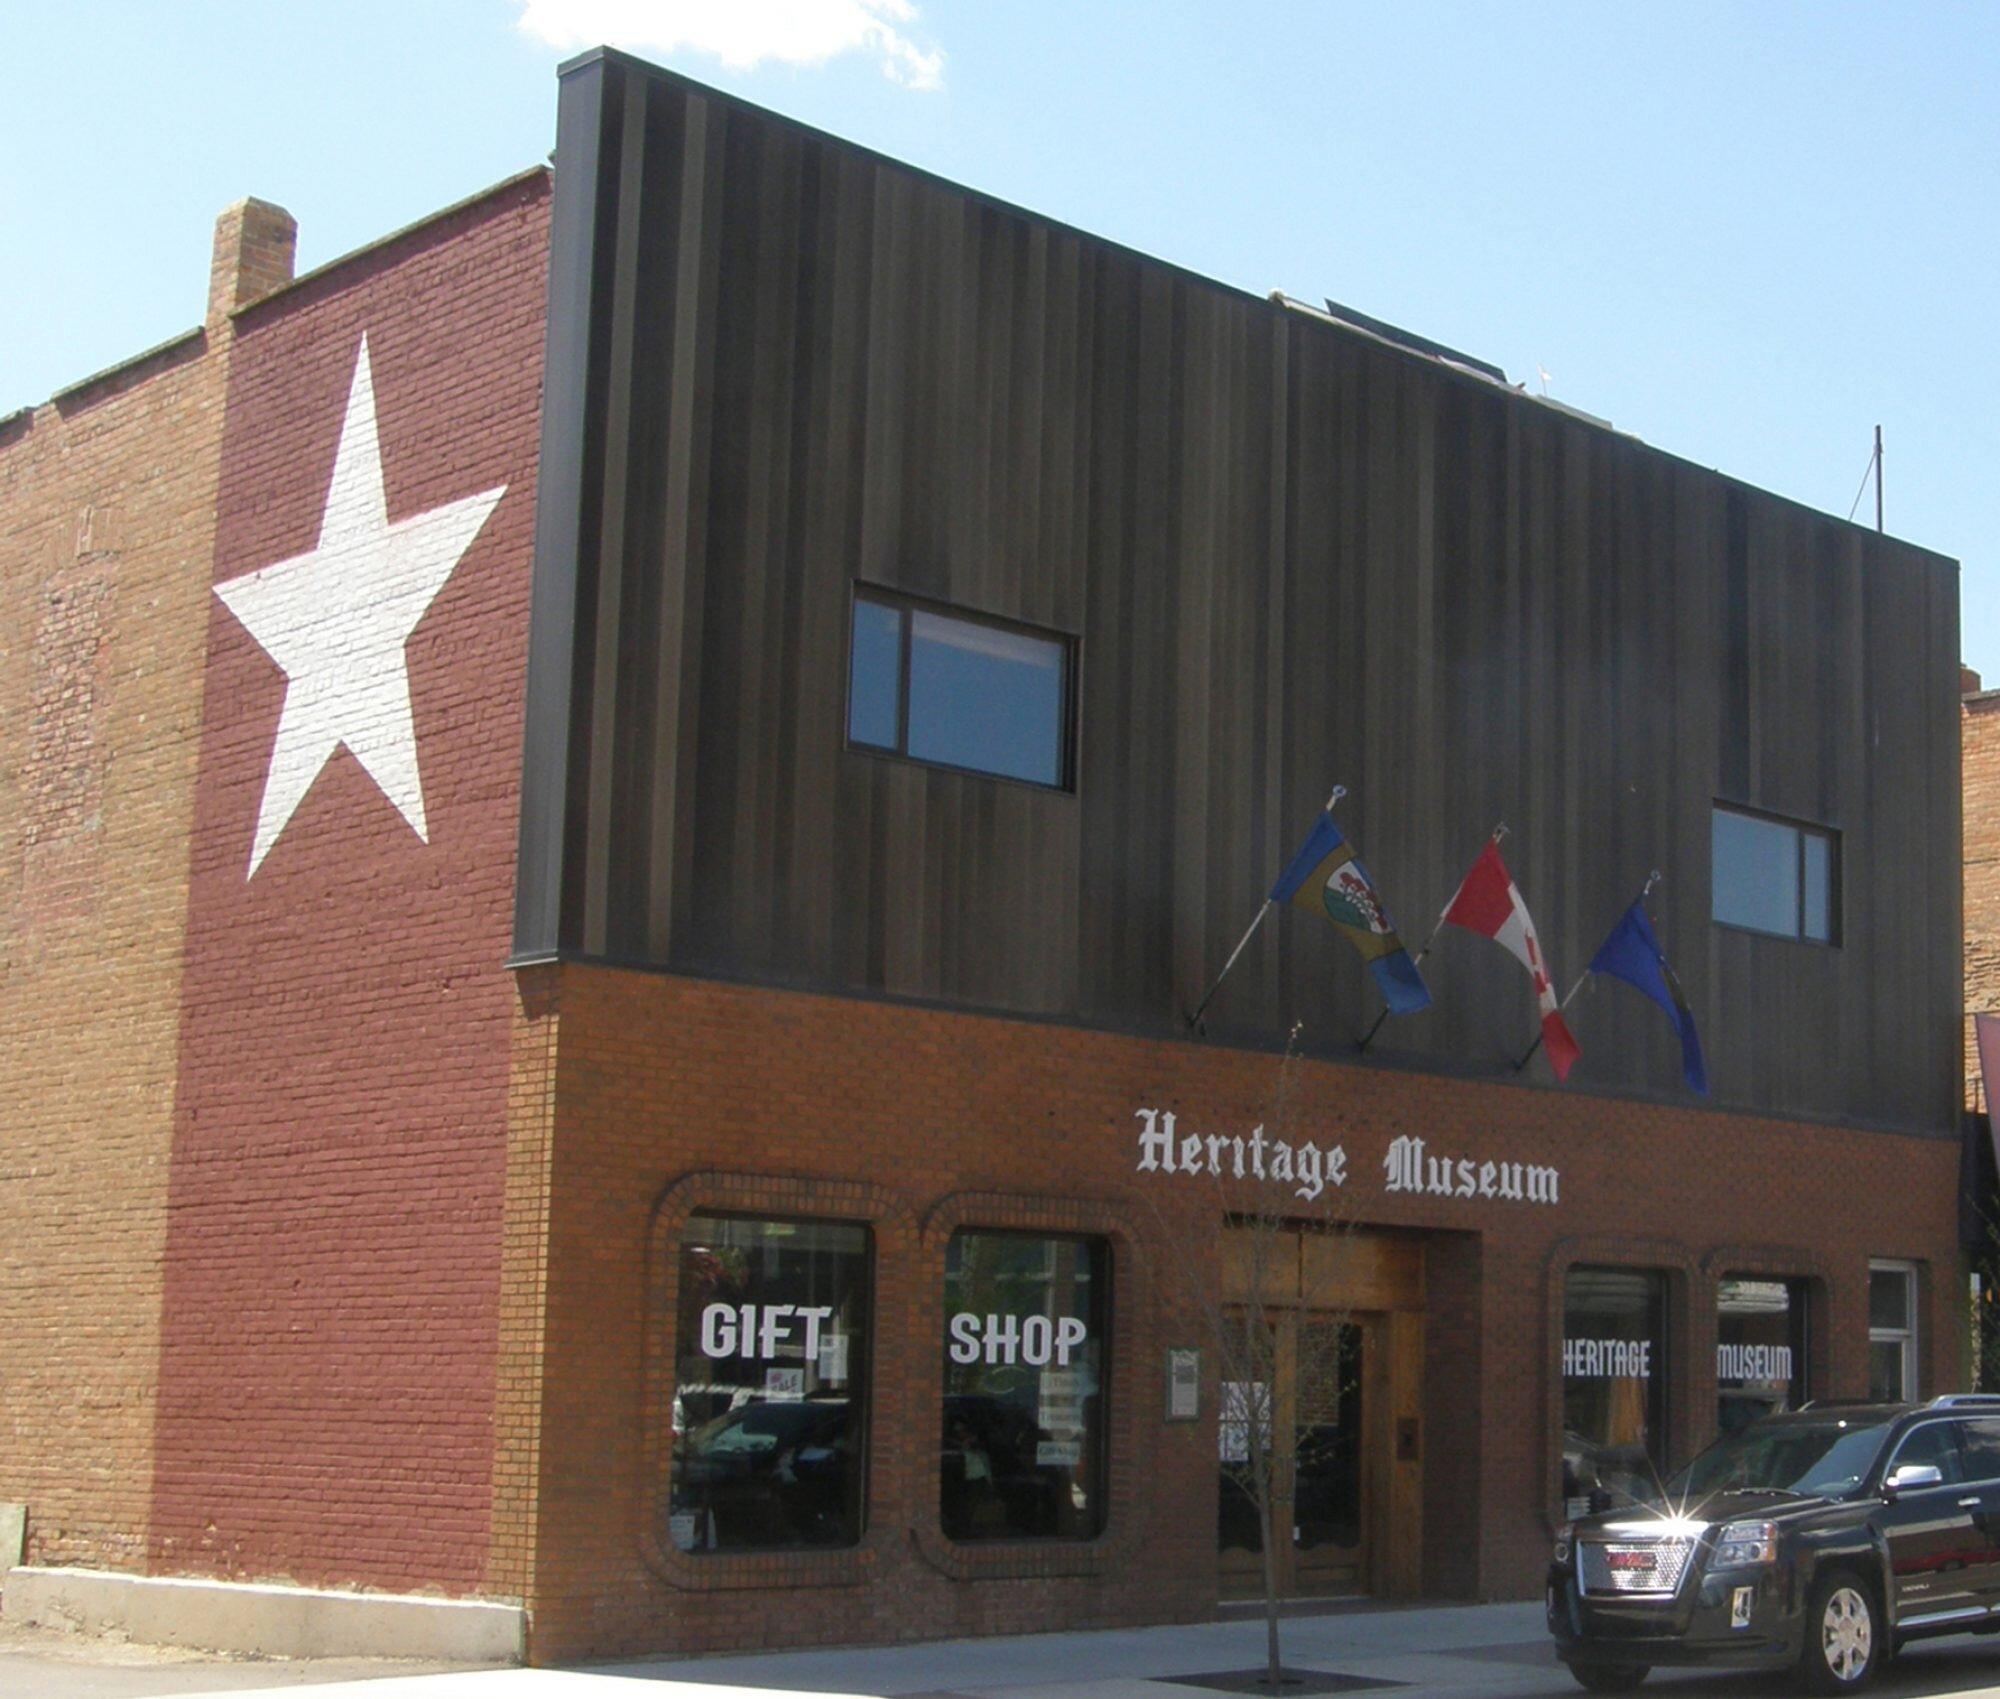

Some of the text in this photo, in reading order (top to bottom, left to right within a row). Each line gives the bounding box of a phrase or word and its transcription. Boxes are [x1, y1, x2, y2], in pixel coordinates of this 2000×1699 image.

[1136, 1108, 1559, 1203] Heritage Museum
[702, 1303, 832, 1360] GIFT
[950, 1313, 1086, 1365] SHOP
[1563, 1339, 1651, 1377] HERITAGE
[1717, 1344, 1792, 1379] MUSEUM
